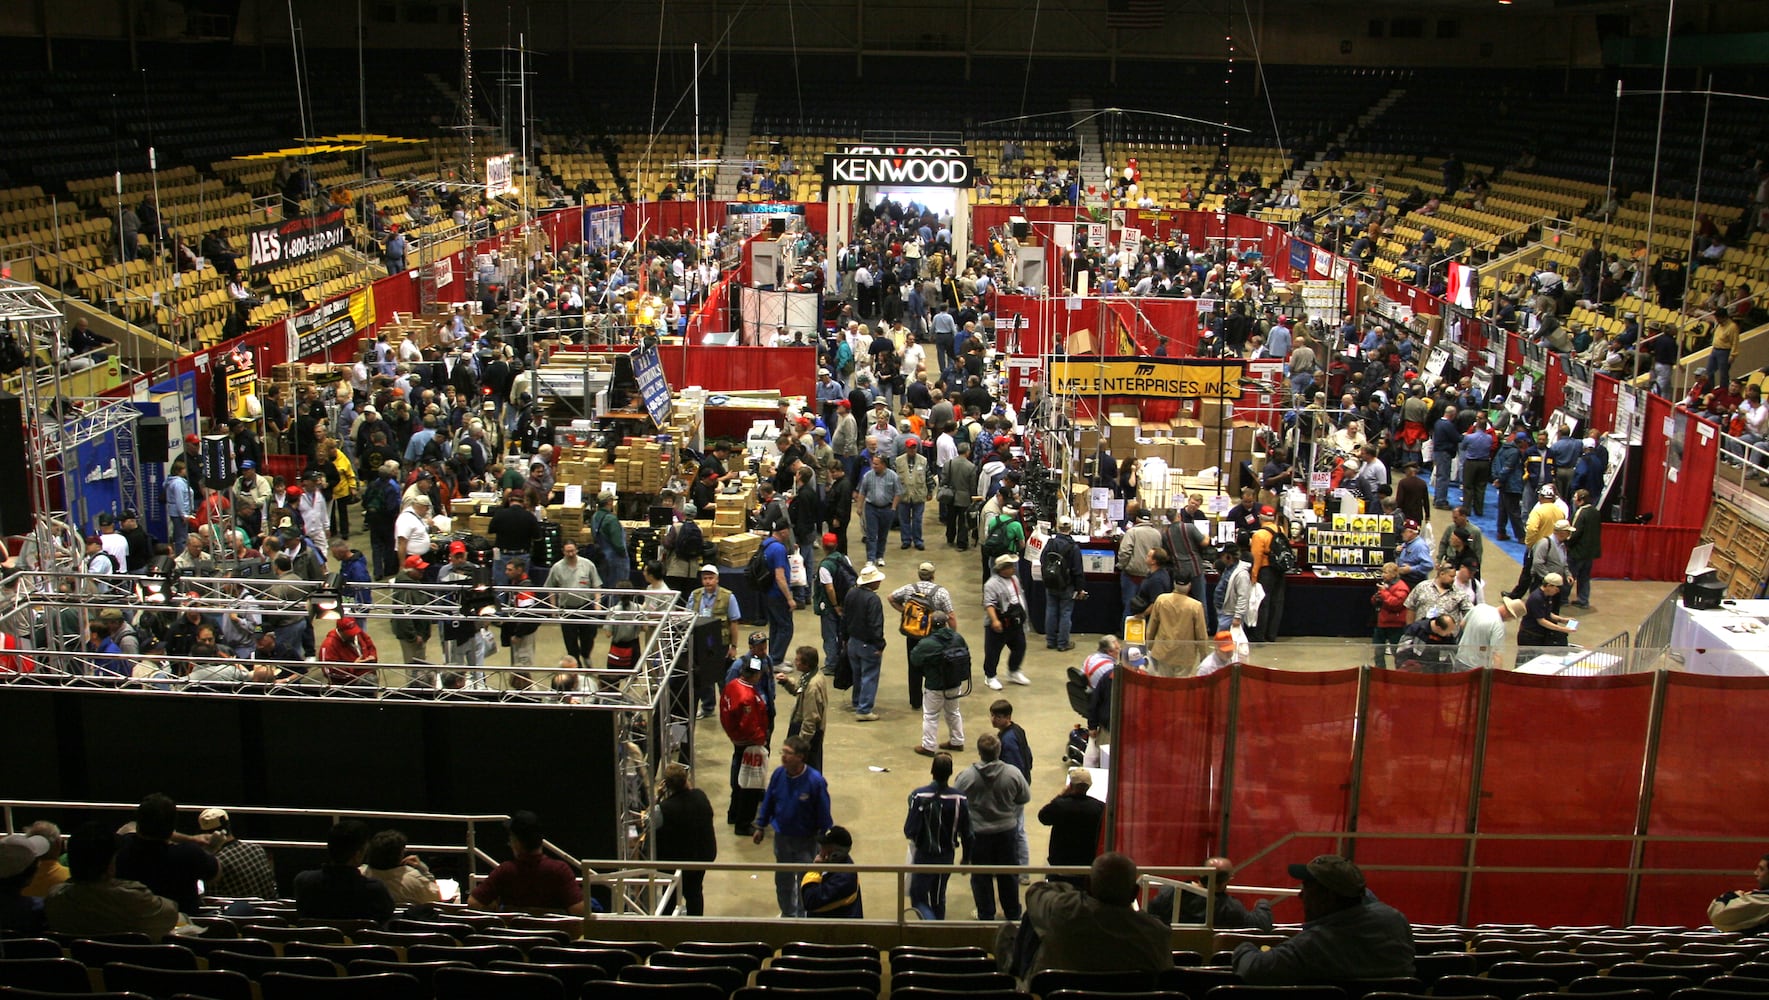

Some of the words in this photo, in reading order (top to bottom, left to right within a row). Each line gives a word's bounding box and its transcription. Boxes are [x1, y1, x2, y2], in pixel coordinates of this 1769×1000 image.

[832, 158, 968, 183] KENWOOD
[251, 228, 281, 266] AES
[1058, 378, 1087, 391] MFJ
[1204, 382, 1233, 395] INC.
